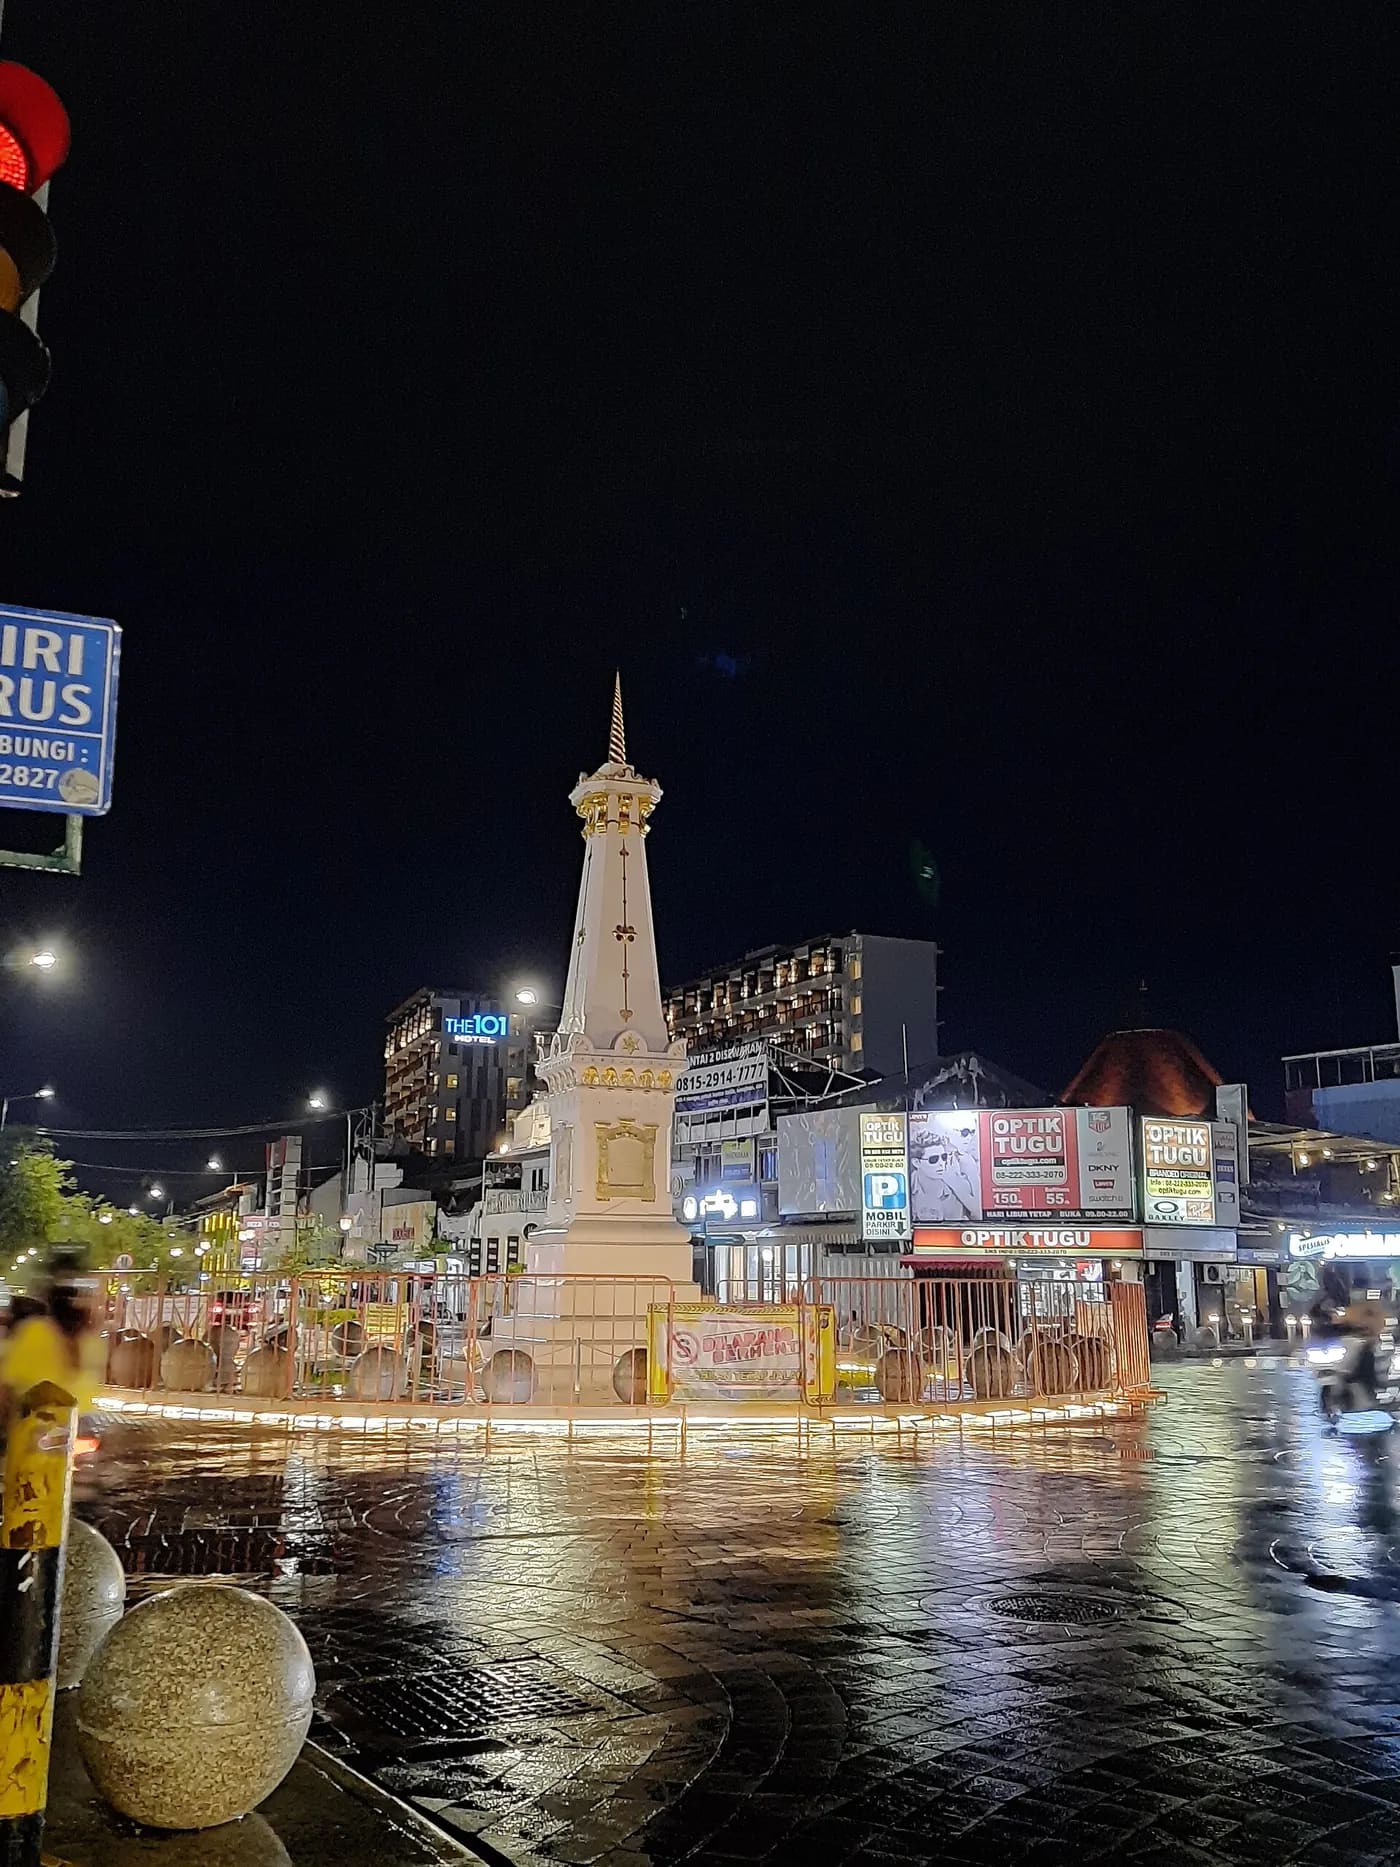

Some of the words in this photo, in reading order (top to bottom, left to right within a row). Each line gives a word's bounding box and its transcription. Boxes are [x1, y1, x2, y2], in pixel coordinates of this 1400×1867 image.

[1, 625, 84, 676] IRI
[0, 764, 59, 789] 2827
[445, 1018, 474, 1034] THE
[473, 1015, 507, 1036] 101
[454, 1035, 496, 1044] HOTEL
[676, 1062, 765, 1091] 0815-2914-7777
[866, 1121, 900, 1131] OPTIK
[993, 1117, 1061, 1134] OPTIK
[863, 1131, 904, 1143] TUGU
[994, 1135, 1062, 1154] TUGU
[1149, 1126, 1206, 1146] OPTIK
[1150, 1145, 1207, 1167] TUGU
[1088, 1164, 1119, 1172] DKNY
[871, 1175, 899, 1207] P
[866, 1211, 907, 1221] MOBIL
[1059, 1210, 1081, 1218] BUKA
[960, 1230, 1027, 1247] OPTIK
[1028, 1230, 1091, 1247] TUGU
[1298, 1238, 1330, 1252] SPESIALIS
[712, 1339, 800, 1364] BERHENT
